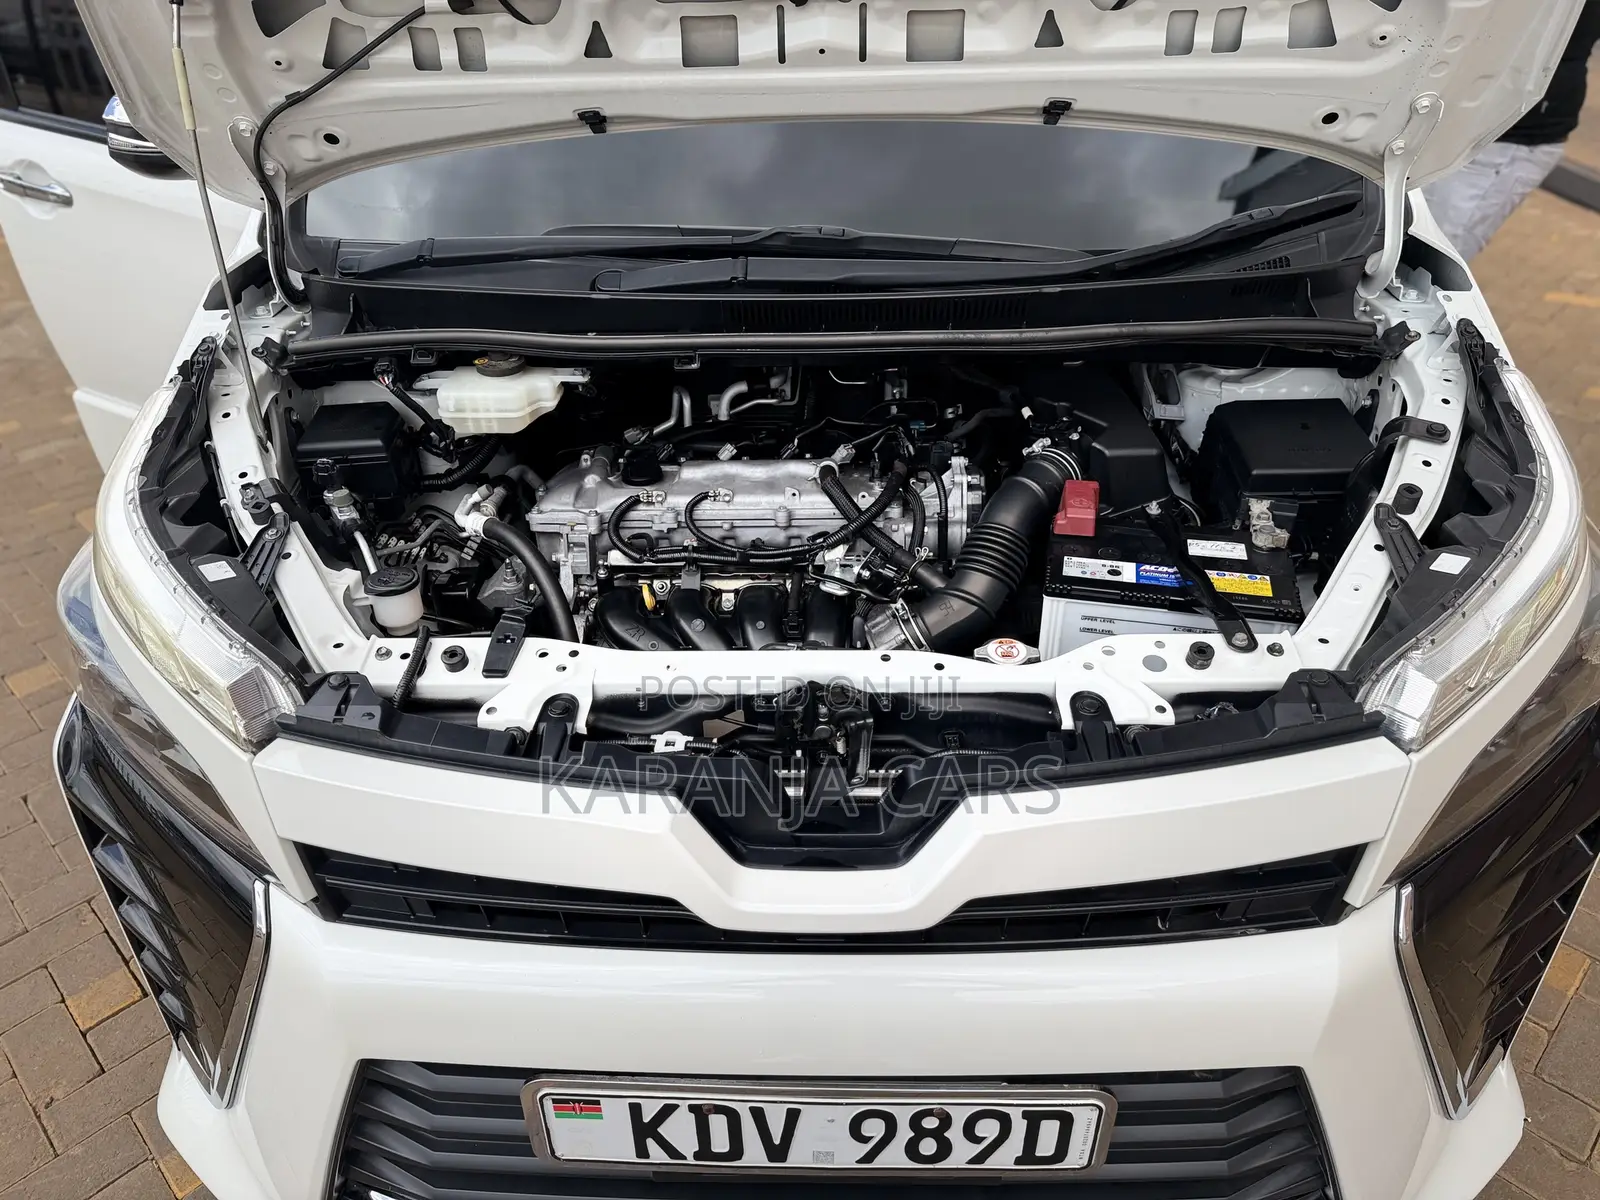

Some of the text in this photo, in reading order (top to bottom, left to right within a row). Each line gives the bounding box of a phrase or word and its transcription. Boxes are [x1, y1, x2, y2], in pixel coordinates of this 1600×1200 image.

[1139, 564, 1179, 573] ACDe
[628, 1102, 1075, 1165] KDV 989D
